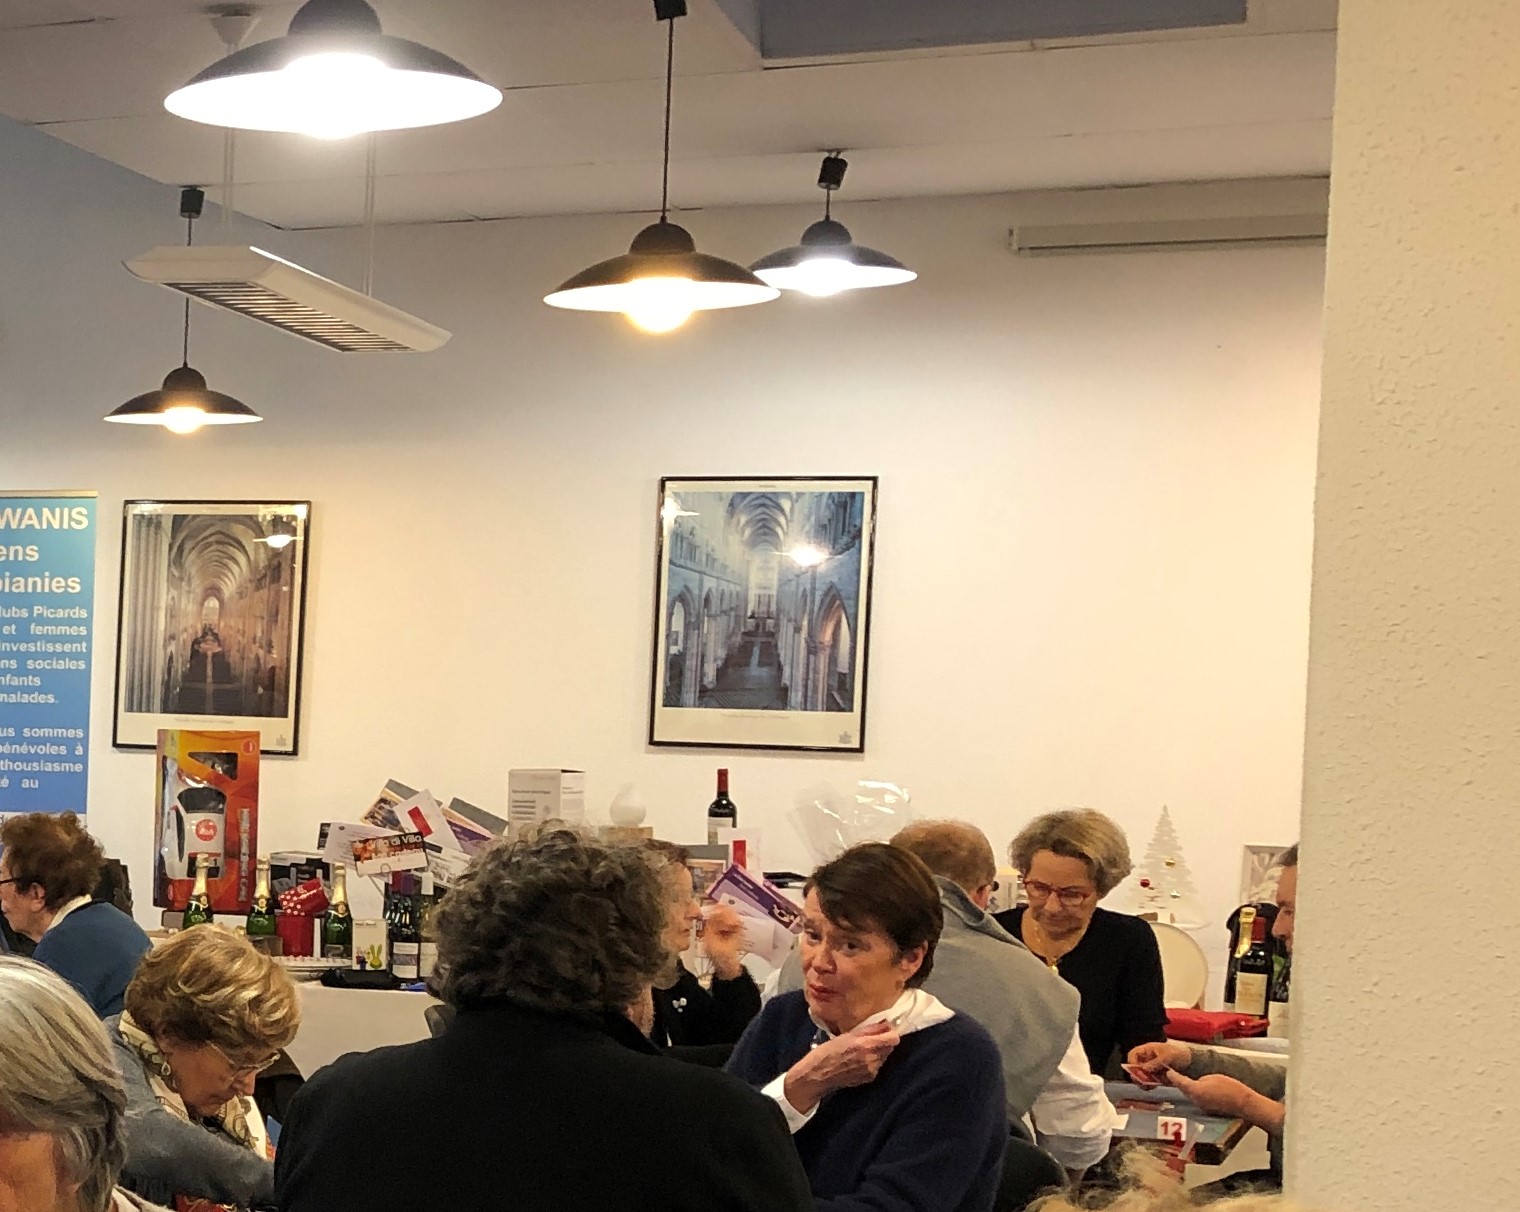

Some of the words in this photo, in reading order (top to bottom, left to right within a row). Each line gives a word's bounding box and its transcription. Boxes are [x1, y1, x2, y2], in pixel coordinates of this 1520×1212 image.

[32, 605, 88, 619] Picards
[1, 623, 17, 635] et
[29, 622, 87, 636] femmes
[26, 656, 86, 670] sociales
[22, 727, 84, 739] sommes
[21, 777, 40, 789] au
